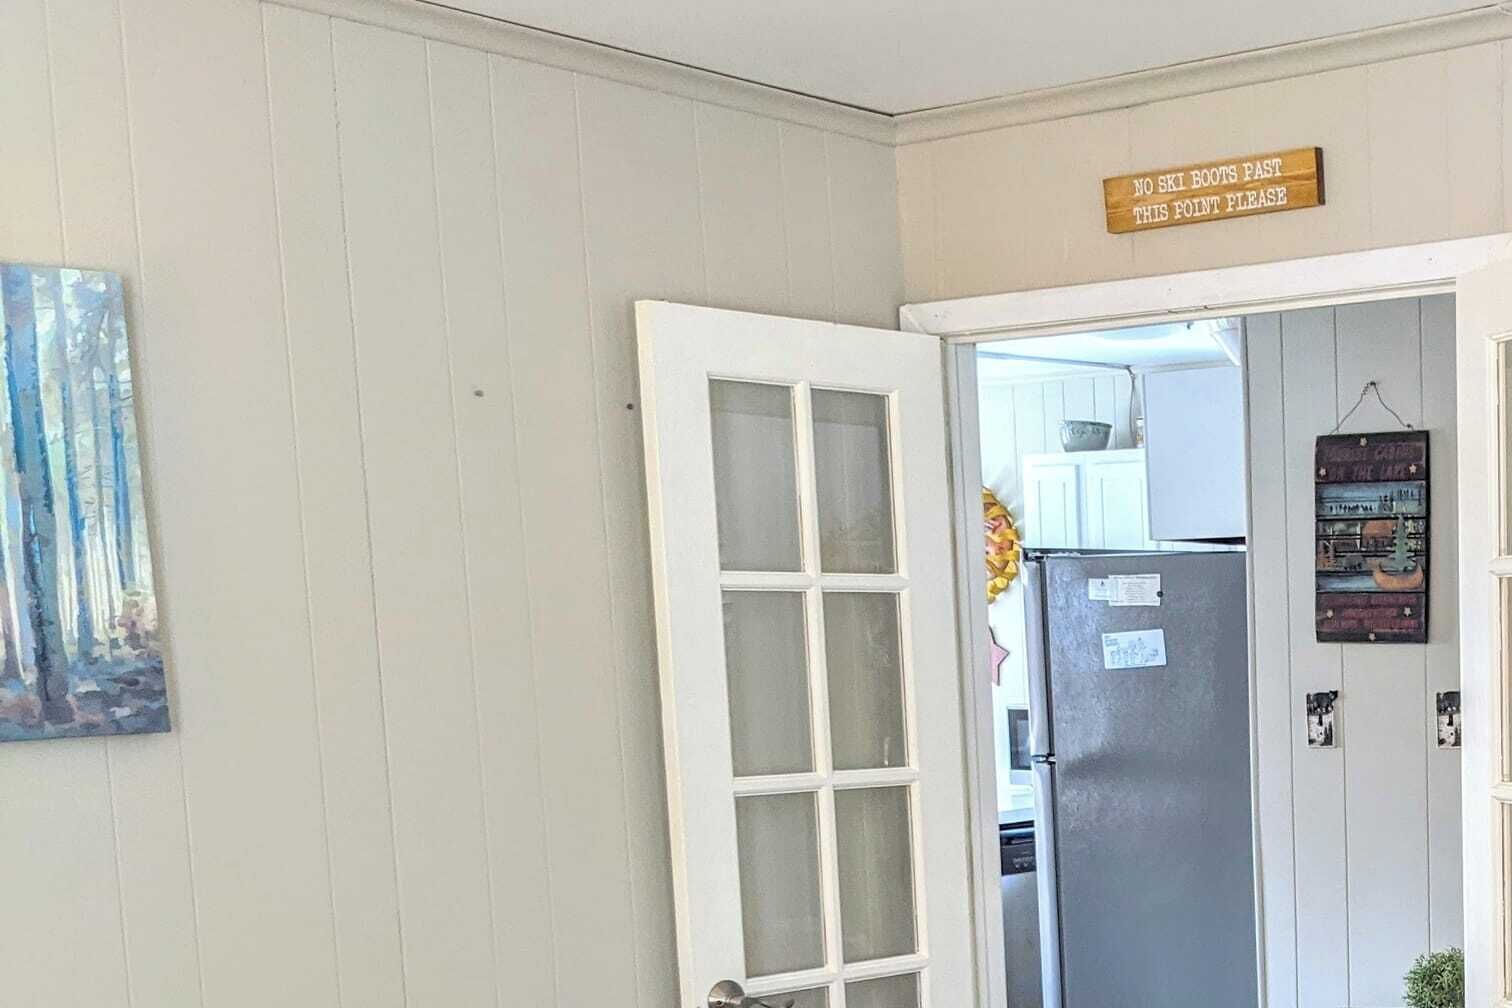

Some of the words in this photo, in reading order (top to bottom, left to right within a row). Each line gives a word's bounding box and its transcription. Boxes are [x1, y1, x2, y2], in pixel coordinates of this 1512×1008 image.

[1133, 178, 1154, 197] NO
[1158, 175, 1186, 194] SKI
[1191, 165, 1239, 190] BOOTS
[1243, 158, 1283, 182] PAST
[1132, 204, 1169, 226] THIS
[1173, 196, 1221, 220] POINT
[1225, 186, 1288, 213] PLEASE
